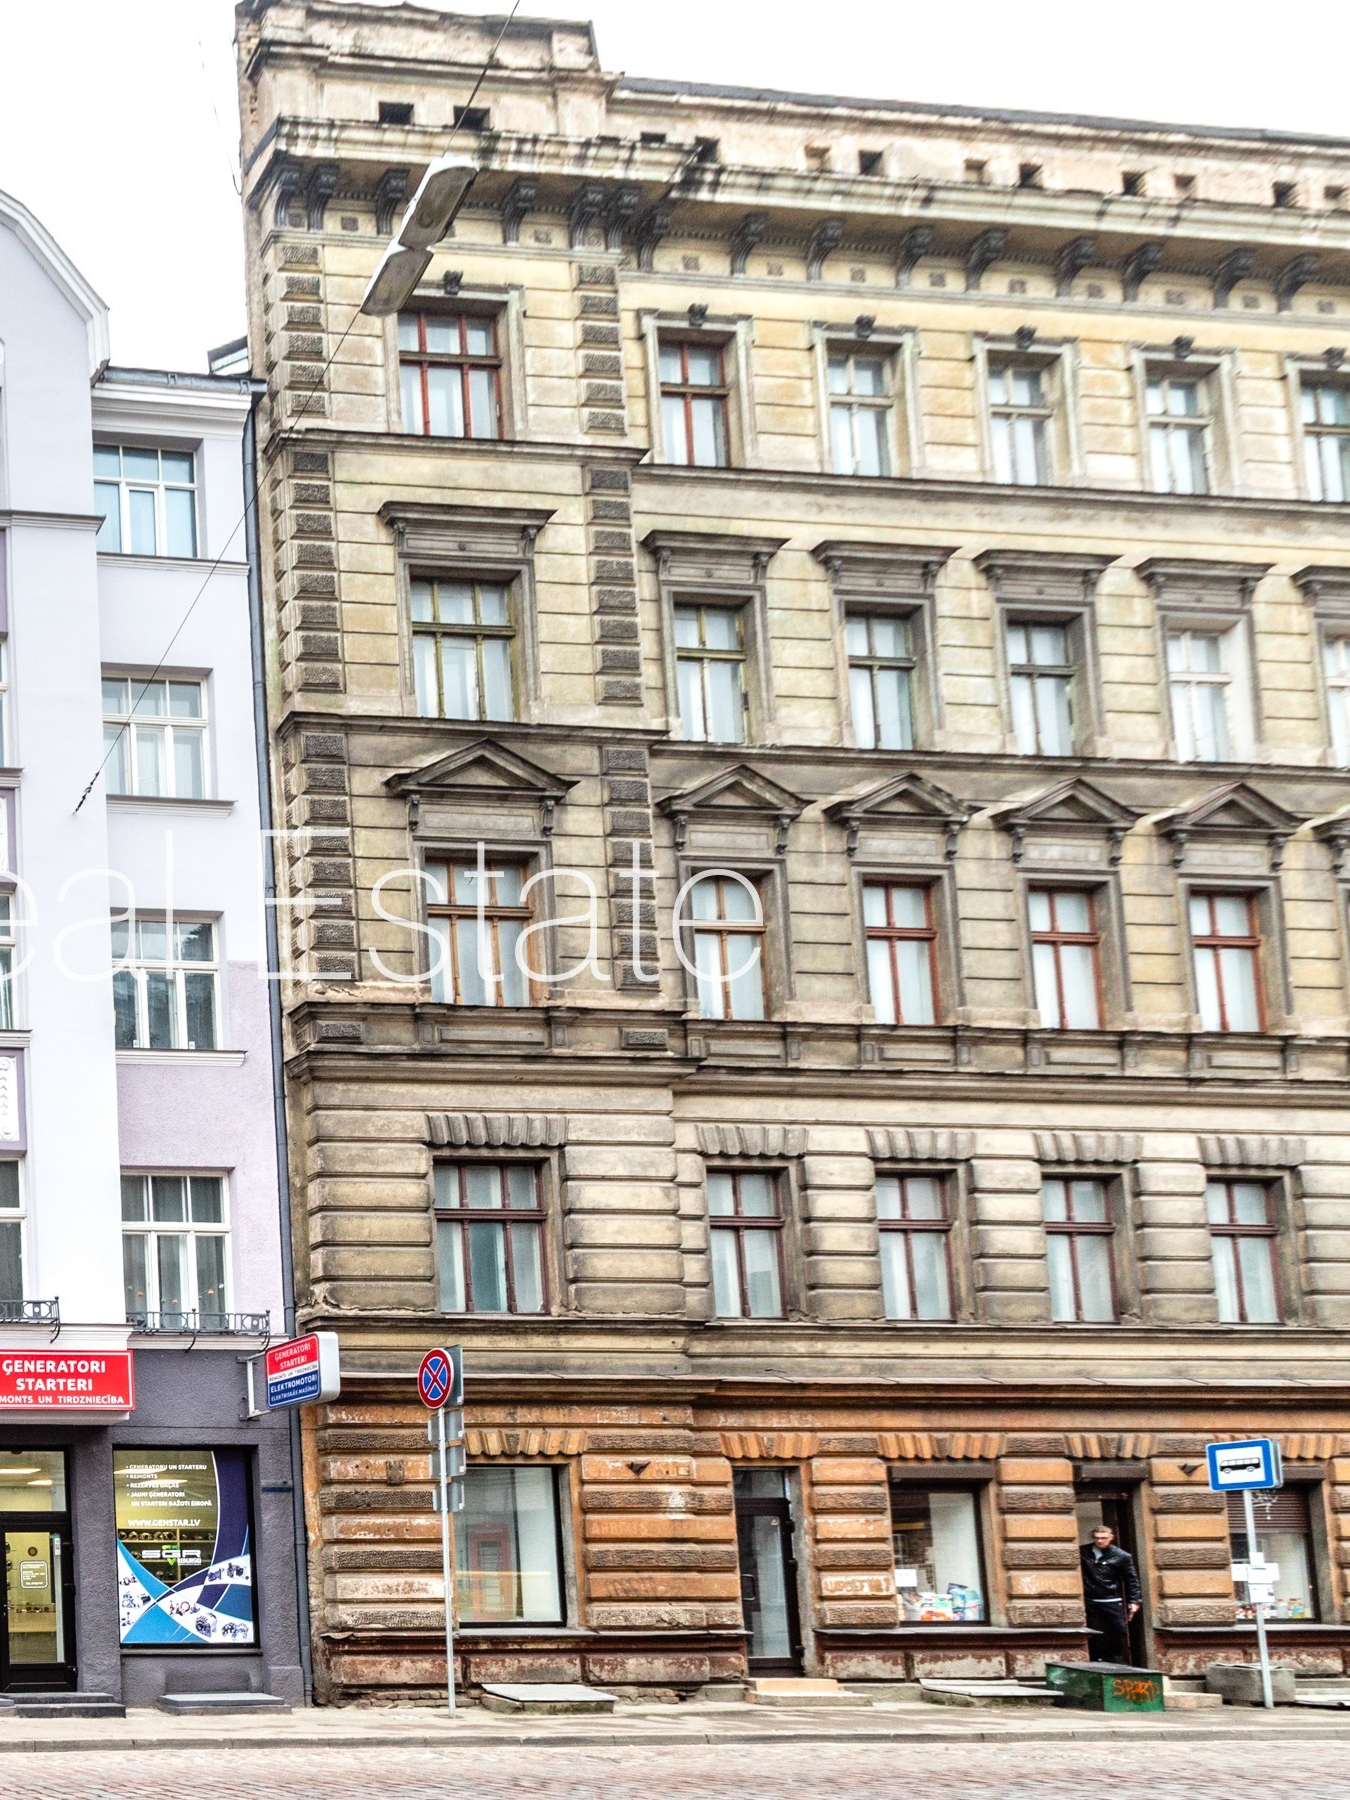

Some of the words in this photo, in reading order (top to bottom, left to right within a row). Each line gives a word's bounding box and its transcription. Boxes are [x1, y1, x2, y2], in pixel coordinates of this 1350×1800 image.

[274, 1342, 310, 1362] ĢENERATORI
[2, 1360, 106, 1376] ĢENERATORI
[280, 1356, 307, 1370] STARTERI
[16, 1378, 92, 1391] STARTERI
[270, 1374, 318, 1394] ELEKTROMOTORI
[38, 1396, 52, 1404] UN
[57, 1394, 124, 1404] TIRDZNIECĪBA
